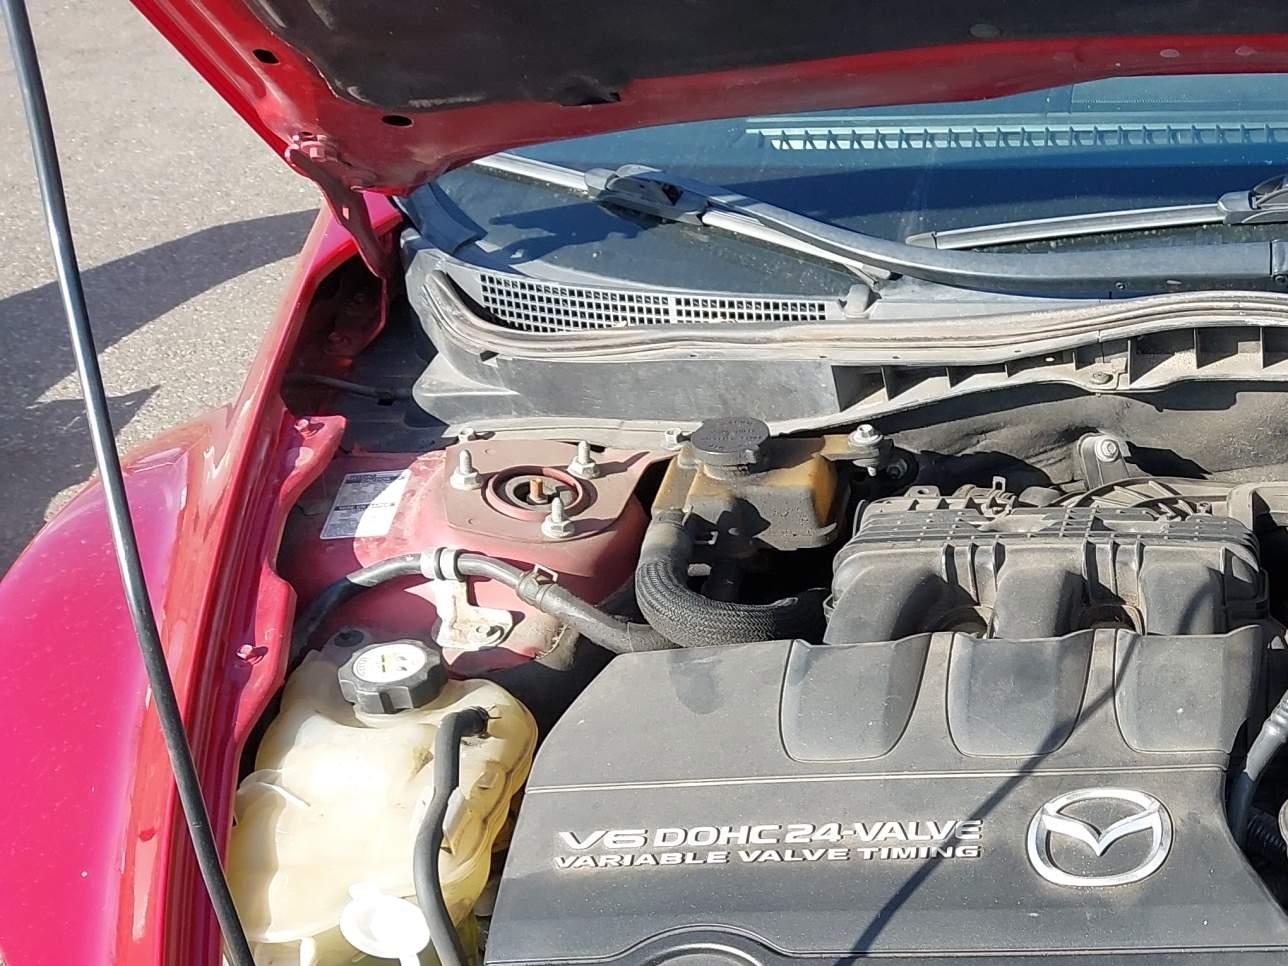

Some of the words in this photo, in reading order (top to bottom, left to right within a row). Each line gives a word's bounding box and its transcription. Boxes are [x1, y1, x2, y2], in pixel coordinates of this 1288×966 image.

[558, 829, 648, 850] V6
[653, 824, 782, 848] DOHC
[785, 820, 984, 843] 24-VALVE
[554, 851, 730, 868] VARIABLE
[738, 848, 850, 863] VALVE
[858, 845, 983, 861] TIMING
